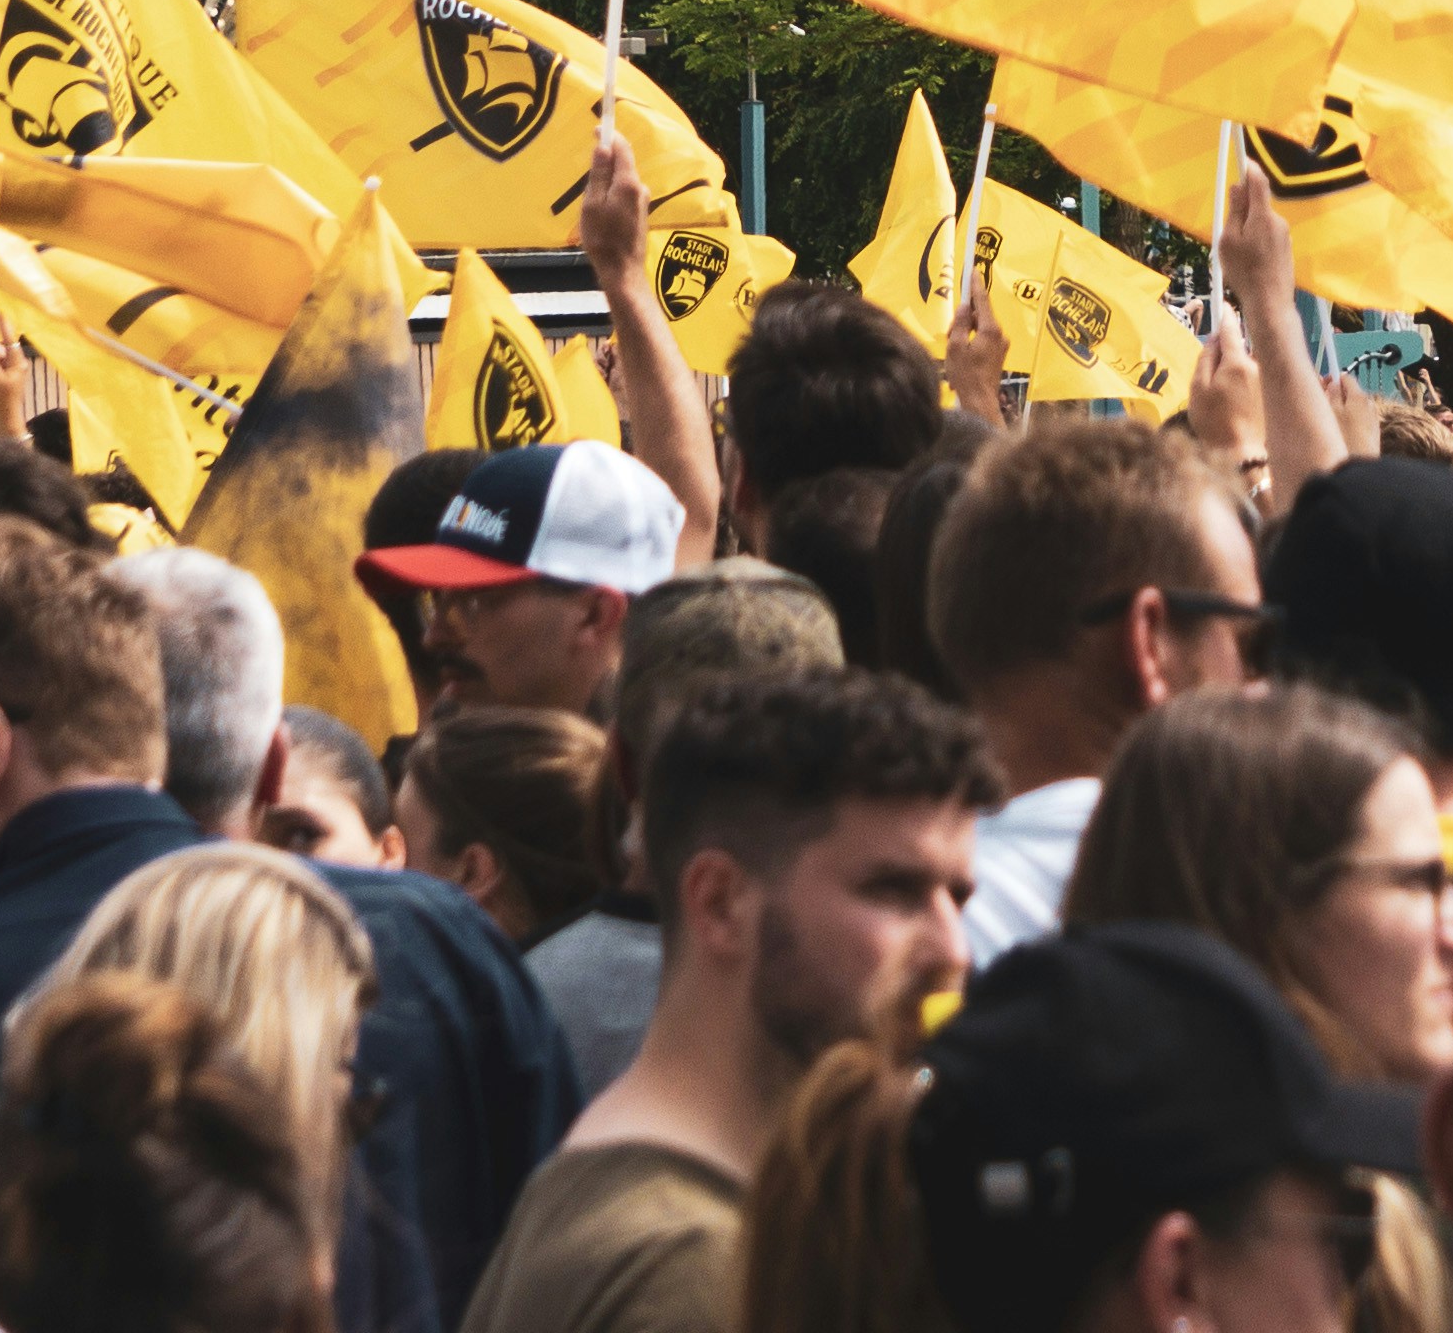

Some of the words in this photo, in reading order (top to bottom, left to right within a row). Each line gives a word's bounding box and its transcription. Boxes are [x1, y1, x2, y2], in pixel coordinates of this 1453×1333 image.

[664, 244, 726, 273] ROCHELAIS
[686, 239, 713, 255] STADE
[1070, 289, 1098, 314] STADE
[1050, 293, 1107, 340] OCHELAIS
